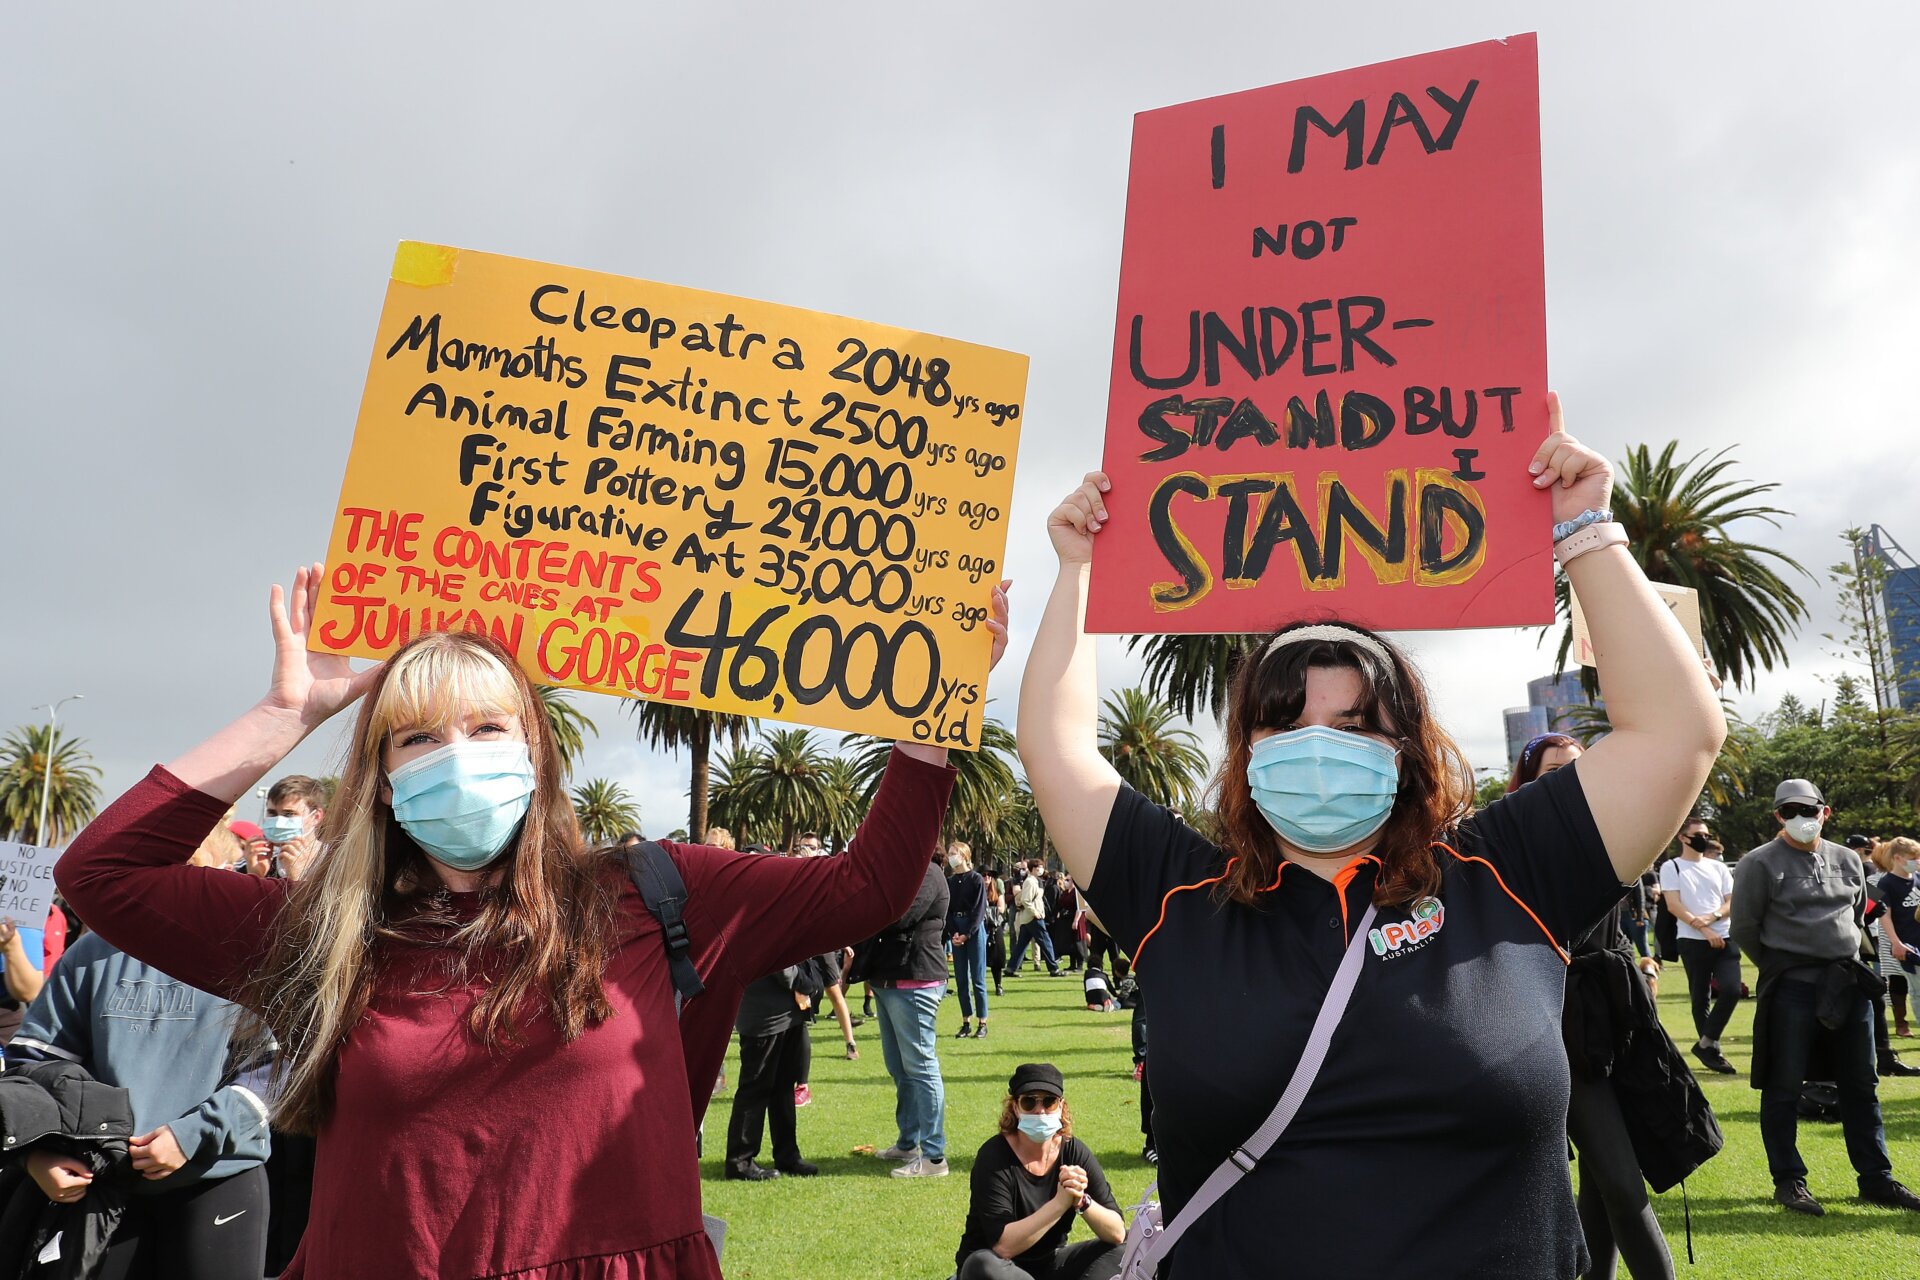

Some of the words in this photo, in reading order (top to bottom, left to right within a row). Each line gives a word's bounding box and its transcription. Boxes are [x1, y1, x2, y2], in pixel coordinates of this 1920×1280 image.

[1210, 124, 1226, 189] I
[1287, 79, 1480, 174] MAY
[1252, 217, 1358, 260] NOT
[530, 284, 804, 370] Cleopatra
[828, 338, 953, 406] 2048
[953, 393, 980, 419] yrs
[985, 402, 1020, 427] ago
[1129, 295, 1435, 390] UNDER-
[386, 313, 588, 389] Mammoths
[605, 354, 804, 427] Extinct
[810, 392, 928, 460] 2500
[927, 441, 957, 467] yrs
[965, 447, 1006, 477] ago
[1138, 388, 1396, 463] STAND
[1404, 385, 1522, 438] BUT
[405, 382, 571, 440] Animal
[587, 406, 745, 490] Farming
[765, 437, 913, 509] 15,000
[912, 491, 948, 517] yrs
[958, 500, 1000, 530] ago
[1451, 448, 1486, 481] I
[459, 433, 569, 486] First
[584, 457, 753, 539] Pottery
[760, 496, 916, 561] 29,000
[913, 545, 949, 573] yrs
[958, 554, 996, 584] ago
[1148, 467, 1487, 614] STAND
[331, 562, 387, 594] OF
[396, 566, 466, 602] THE
[480, 581, 560, 611] CAVES
[571, 596, 624, 623] AT
[343, 507, 425, 562] THE
[433, 526, 662, 604] CONTENTS
[469, 481, 668, 551] Figurative
[671, 532, 745, 578] Art
[754, 543, 913, 613] 35,000
[904, 591, 945, 616] yrs
[951, 602, 988, 631] ago
[536, 618, 703, 701] GORGE
[664, 587, 941, 718] 46,000
[933, 677, 979, 718] yrs
[911, 710, 973, 747] old
[0, 860, 52, 880] USTICE
[9, 878, 28, 893] NO
[18, 846, 36, 860] NO
[0, 893, 41, 912] EACE
[1382, 935, 1435, 961] AUSTRALIA
